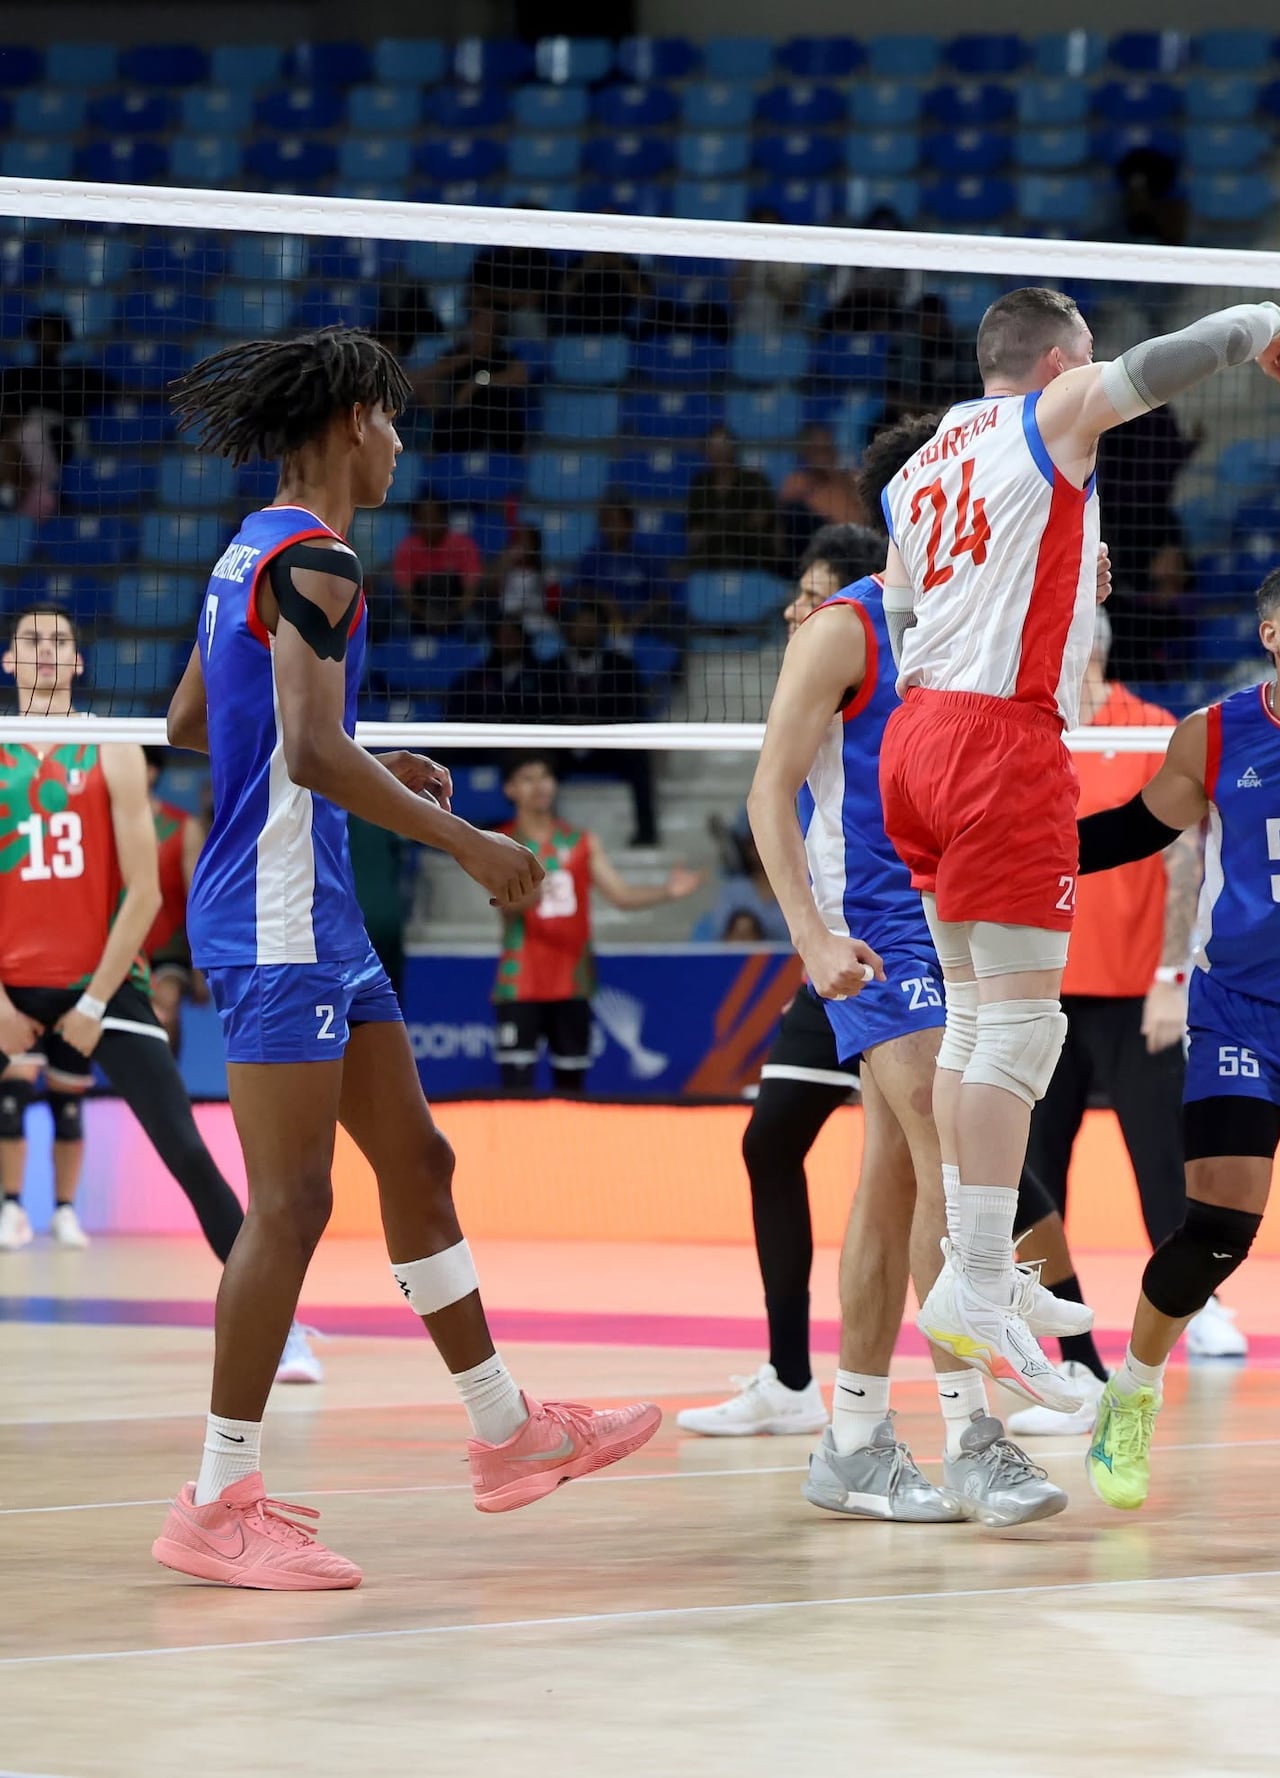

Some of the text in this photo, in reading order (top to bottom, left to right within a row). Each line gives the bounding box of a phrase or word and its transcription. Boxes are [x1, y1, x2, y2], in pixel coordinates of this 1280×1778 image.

[910, 458, 991, 593] 24
[1237, 779, 1262, 788] PEAK
[17, 811, 85, 881] 13
[1055, 876, 1076, 911] 2
[901, 977, 942, 1011] 25
[315, 1005, 336, 1039] 2
[1218, 1046, 1260, 1078] 55
